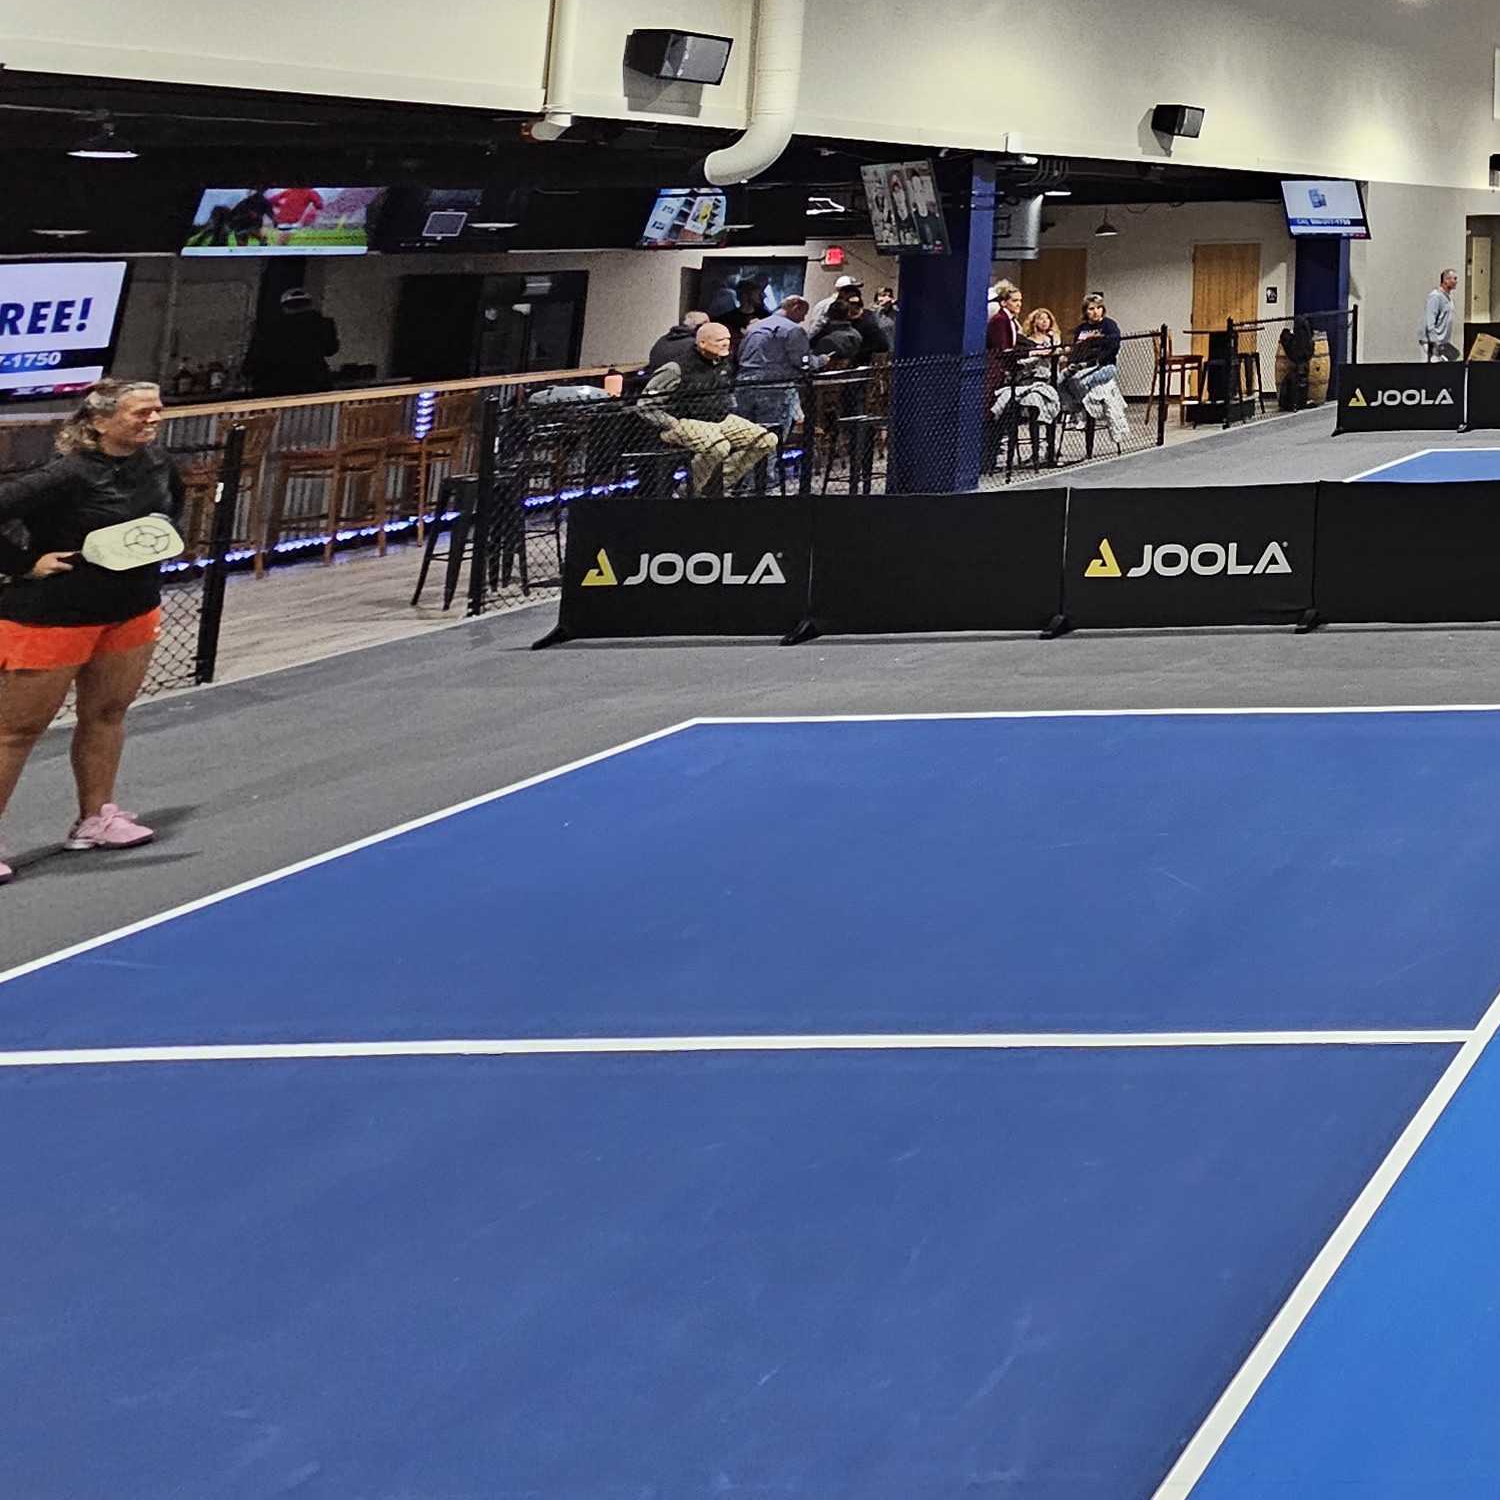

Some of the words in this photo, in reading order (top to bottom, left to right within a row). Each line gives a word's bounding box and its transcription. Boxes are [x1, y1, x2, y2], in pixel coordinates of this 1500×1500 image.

[1370, 388, 1454, 407] JOOLA
[623, 552, 787, 586] JOOLA
[1127, 541, 1293, 578] JOOLA
